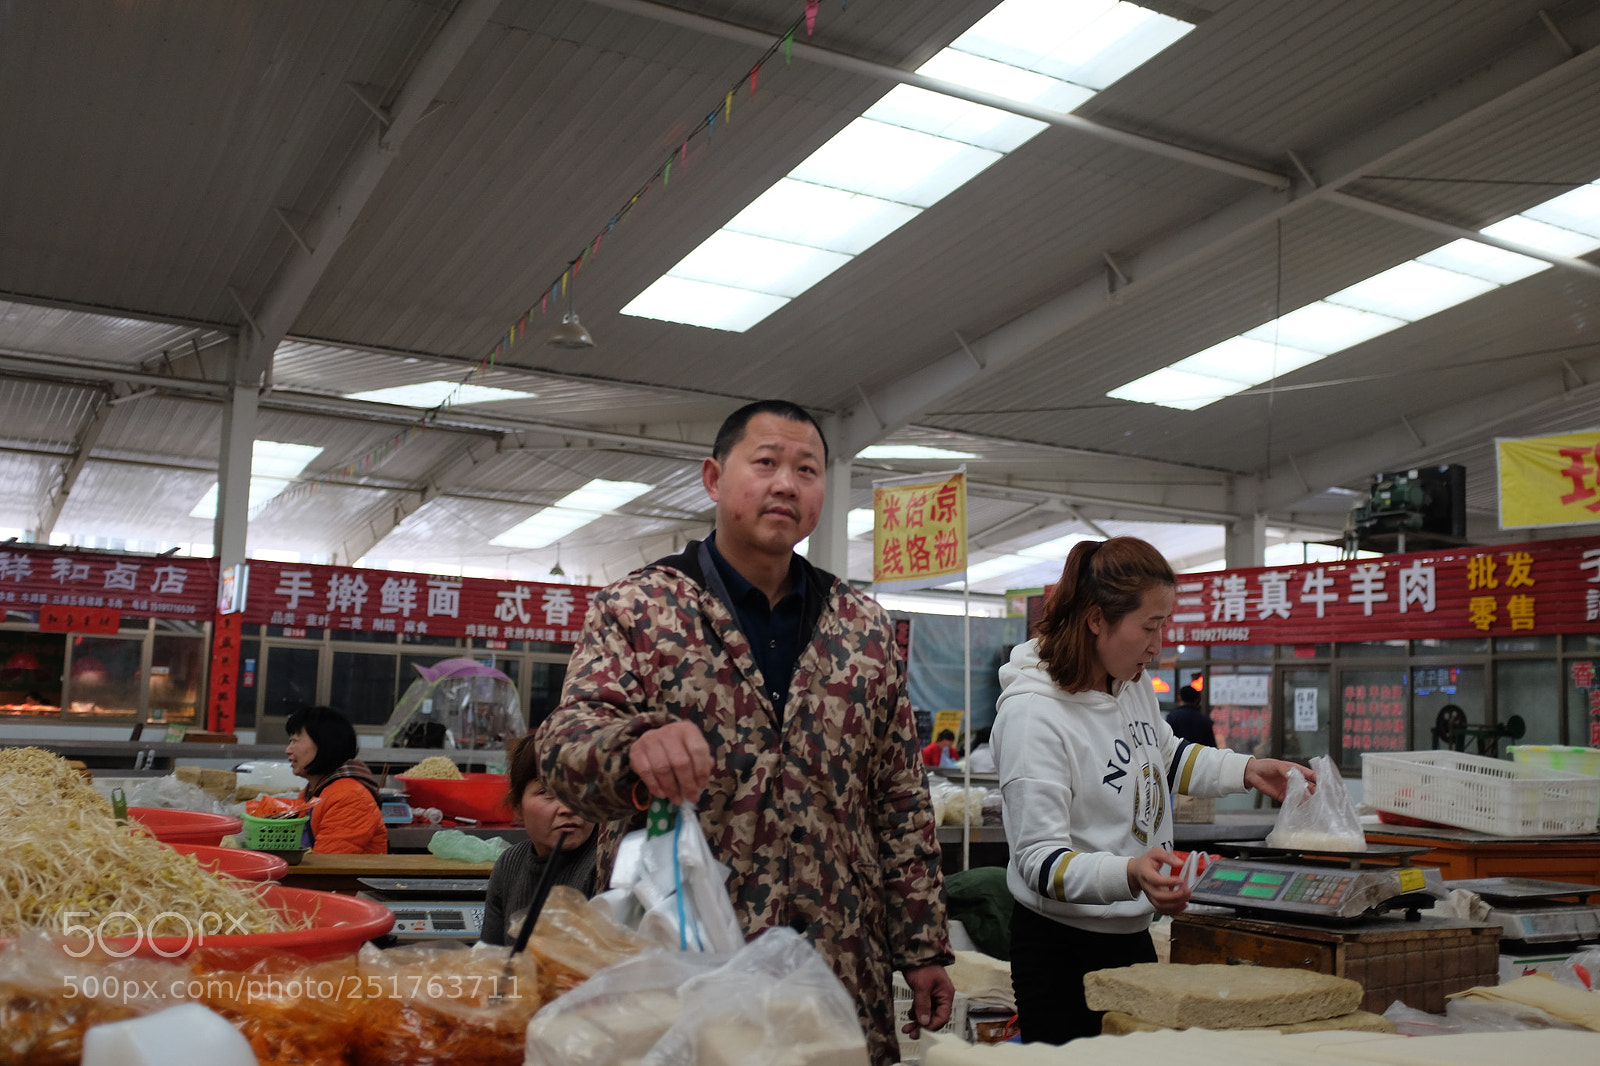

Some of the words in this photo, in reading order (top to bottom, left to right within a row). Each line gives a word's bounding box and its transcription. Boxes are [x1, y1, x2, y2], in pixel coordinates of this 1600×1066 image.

[883, 494, 904, 574] 米线
[1466, 552, 1536, 590] 批发
[275, 570, 462, 619] 手擀鲜面
[1468, 593, 1536, 631] 零售
